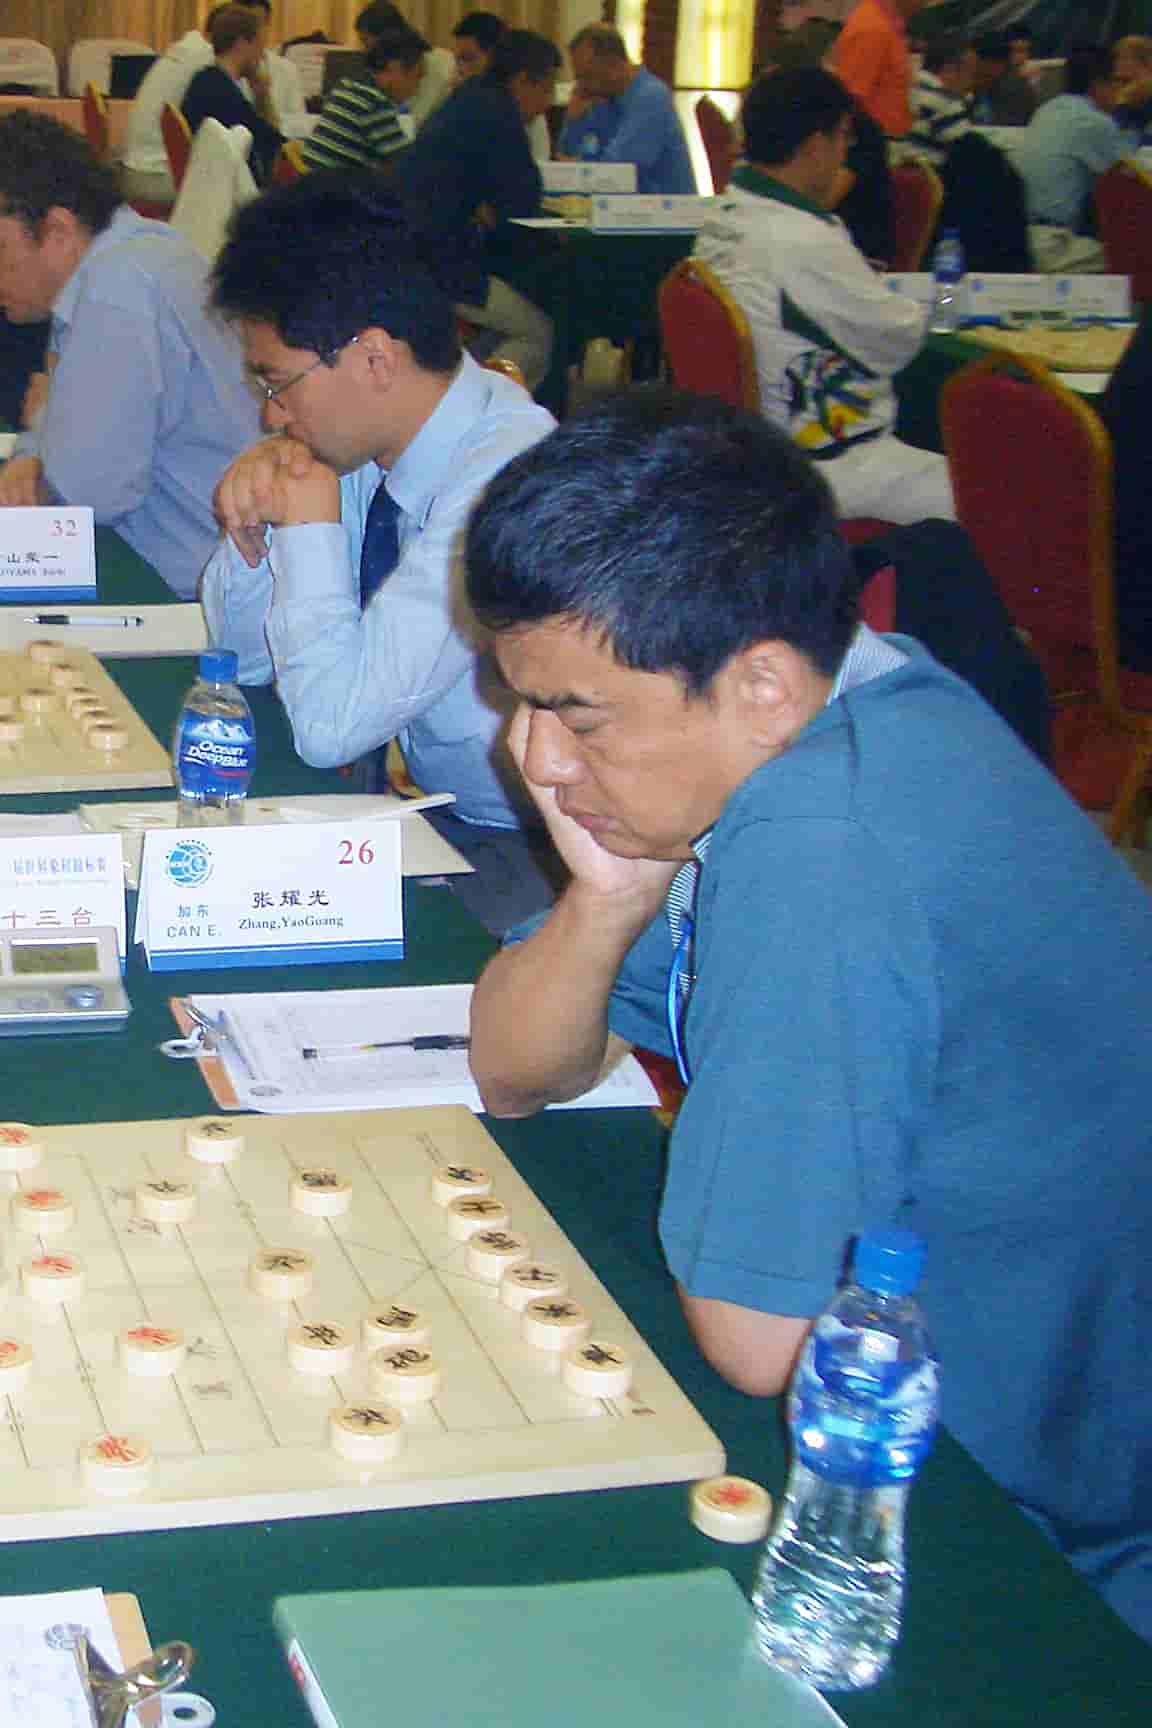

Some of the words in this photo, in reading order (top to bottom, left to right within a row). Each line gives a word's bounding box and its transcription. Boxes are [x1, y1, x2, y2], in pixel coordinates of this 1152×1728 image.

[50, 519, 79, 537] 32
[337, 839, 375, 865] 26
[166, 924, 201, 939] CAN
